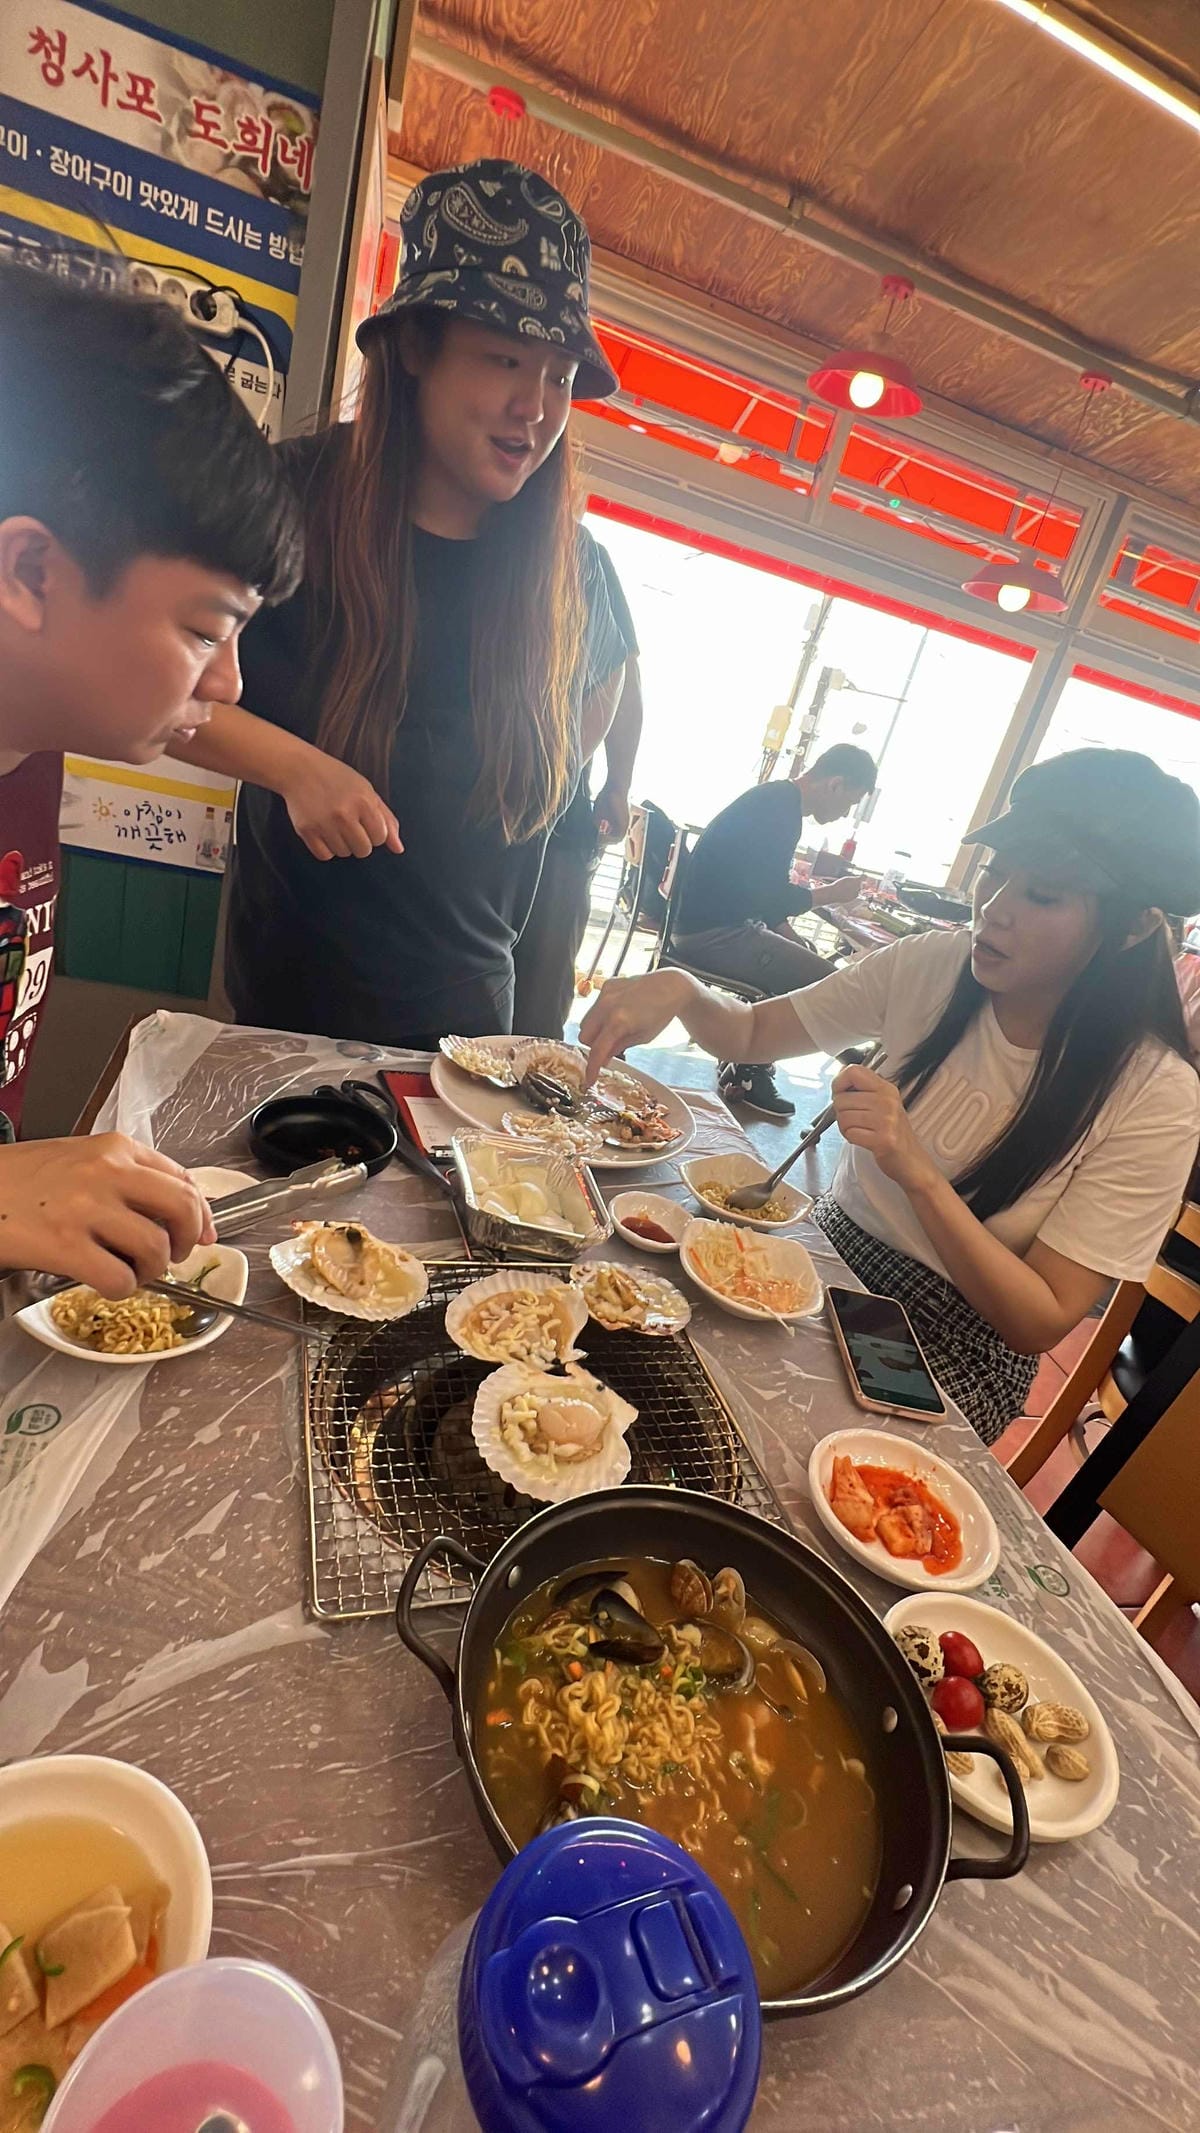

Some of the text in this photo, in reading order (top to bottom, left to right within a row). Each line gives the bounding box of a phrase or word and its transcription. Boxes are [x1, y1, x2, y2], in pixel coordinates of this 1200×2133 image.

[27, 25, 315, 192] 청사포 도희네
[49, 145, 133, 201] 장어구이
[139, 180, 199, 227] 맛있게
[204, 207, 263, 251] 드시는
[114, 823, 187, 851] 깨끗해
[124, 801, 182, 825] 아침이
